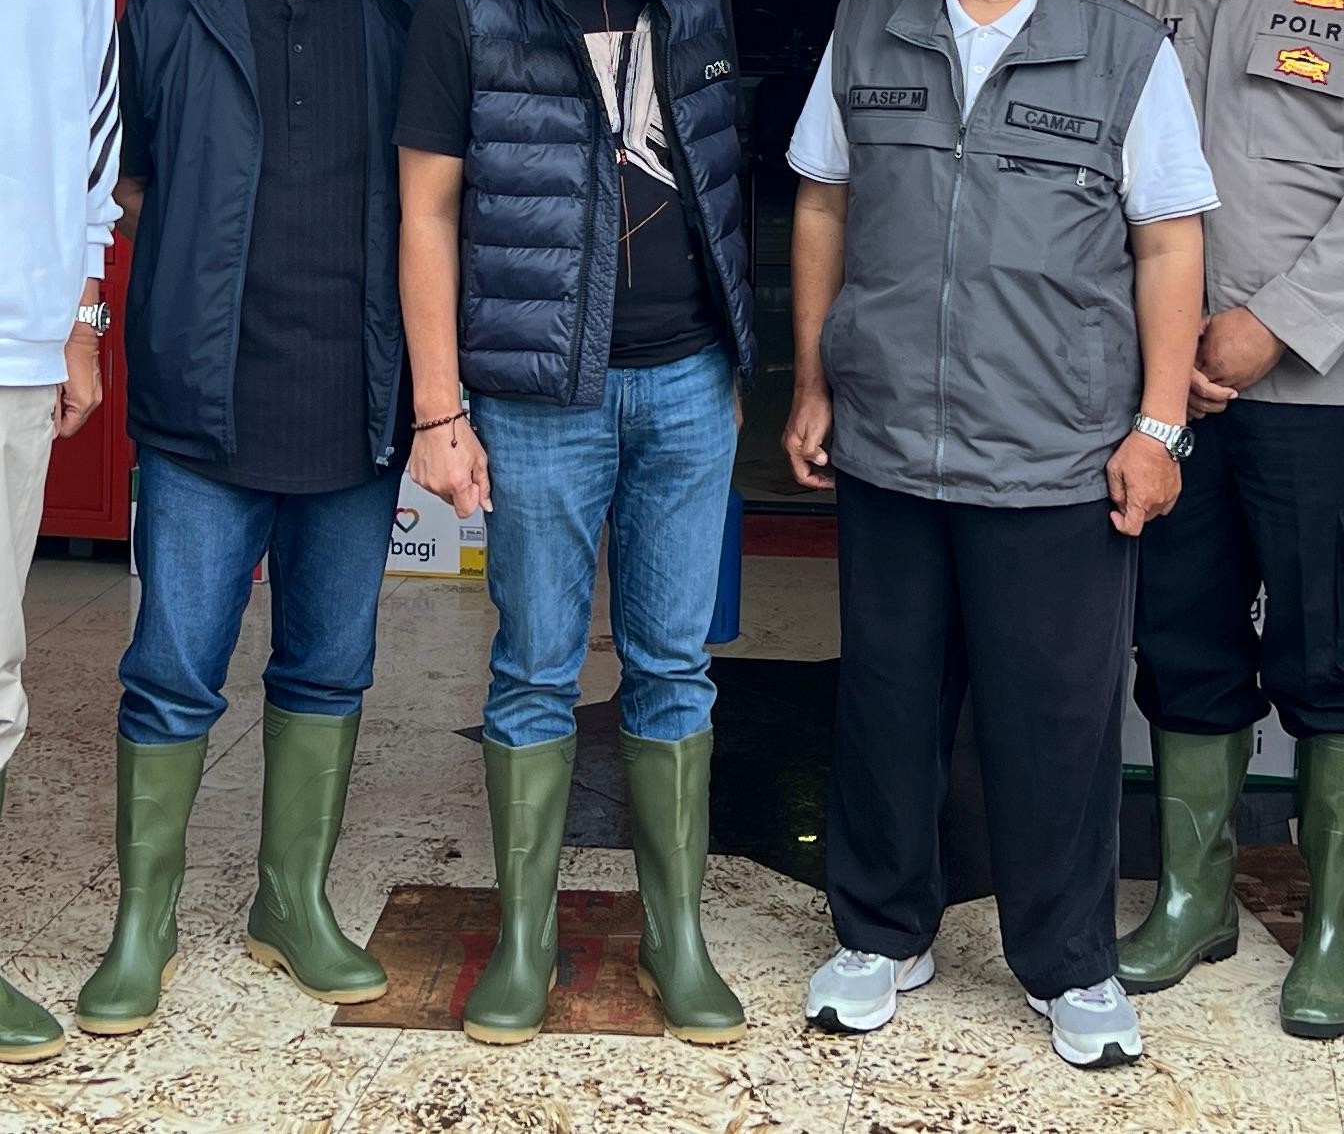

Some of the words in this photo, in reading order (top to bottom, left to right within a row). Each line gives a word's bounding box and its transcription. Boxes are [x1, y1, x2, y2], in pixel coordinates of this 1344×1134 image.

[868, 91, 908, 106] ASEP
[911, 91, 922, 106] M
[1024, 110, 1086, 135] CAMAT
[390, 538, 437, 562] bagi
